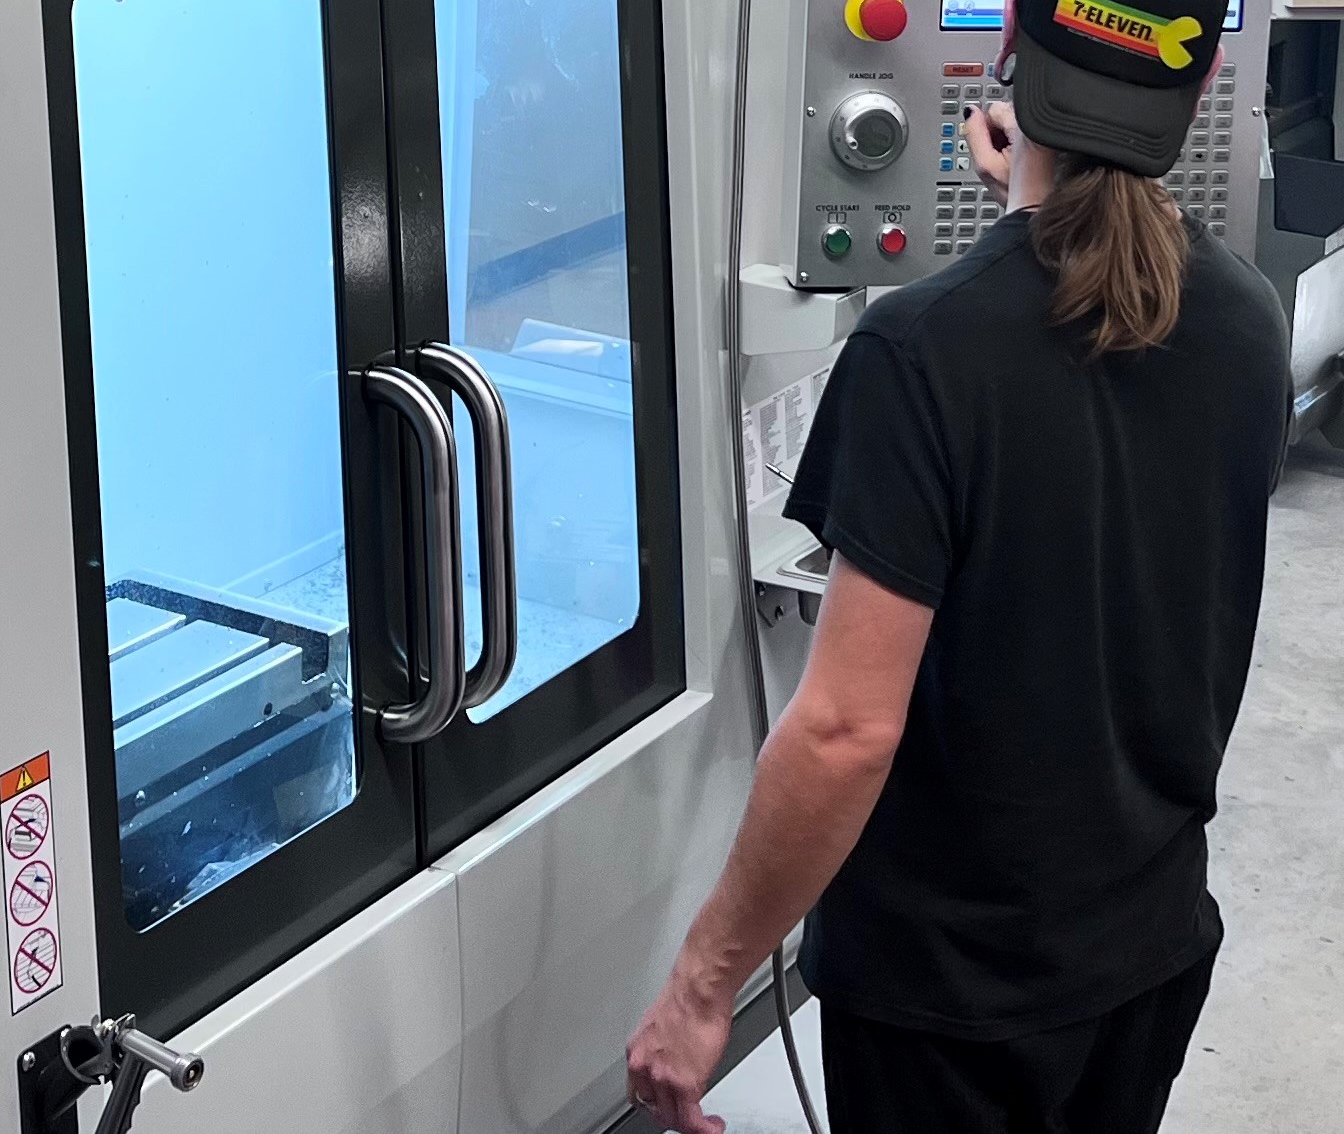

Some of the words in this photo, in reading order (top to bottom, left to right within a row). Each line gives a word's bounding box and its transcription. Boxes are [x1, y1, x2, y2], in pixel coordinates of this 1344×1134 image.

[849, 72, 876, 80] HANDLE
[878, 72, 894, 80] JOG
[816, 204, 838, 212] CYCLE
[840, 204, 860, 212] START
[875, 204, 890, 212] FEED
[892, 204, 911, 212] HOLD
